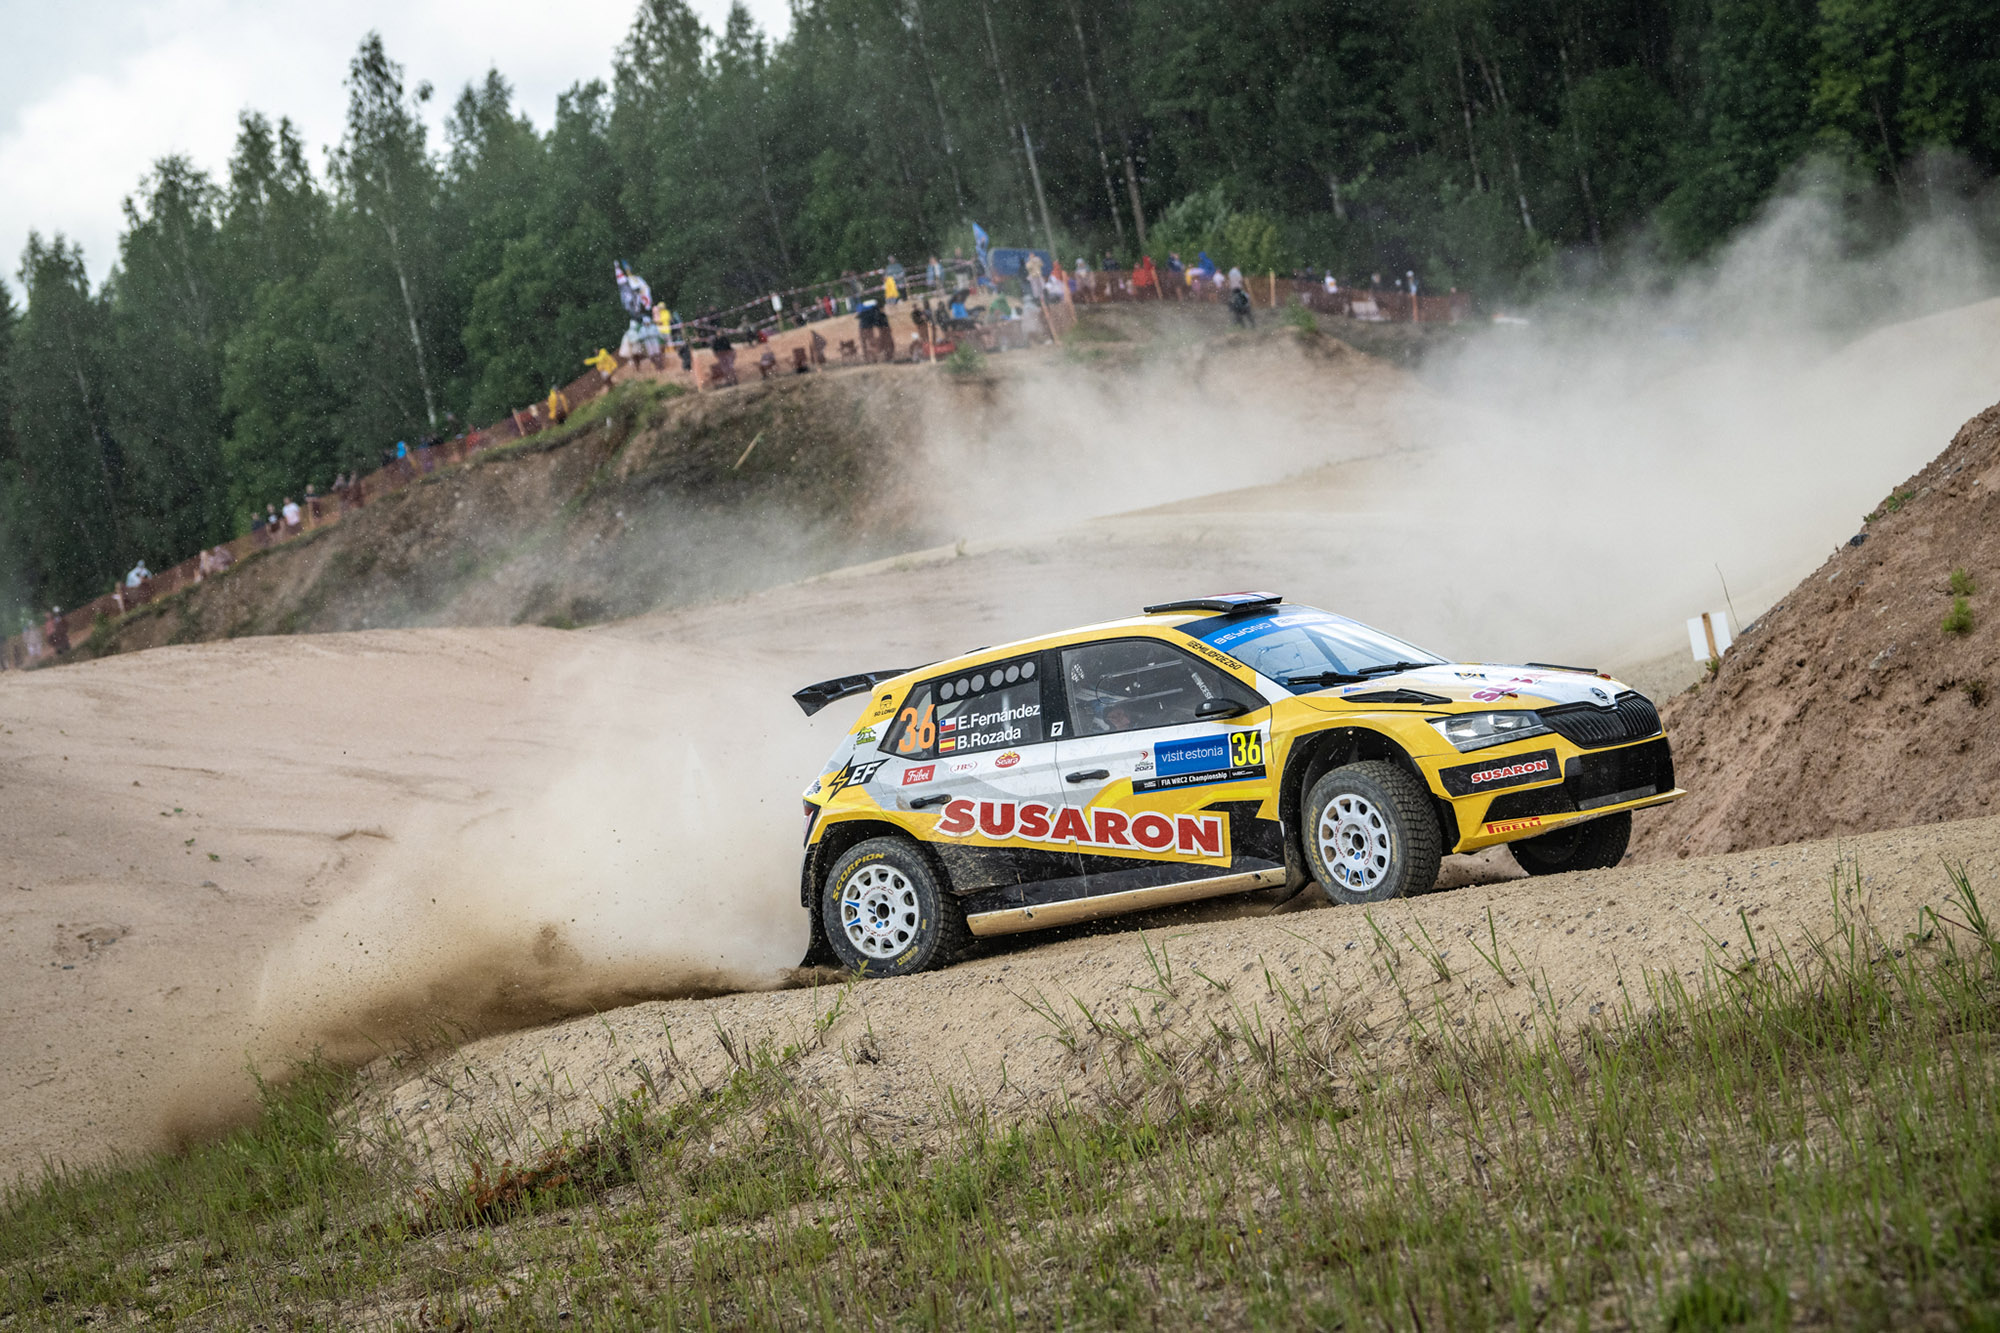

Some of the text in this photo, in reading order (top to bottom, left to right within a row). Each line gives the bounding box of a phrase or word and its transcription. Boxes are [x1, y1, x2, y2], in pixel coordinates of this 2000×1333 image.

[898, 703, 937, 753] 36
[958, 703, 1041, 731] E.Fernández
[957, 727, 1022, 750] B.Rozada
[1231, 731, 1262, 767] 36
[1161, 746, 1224, 763] visit estonia
[847, 762, 882, 786] EF
[954, 763, 973, 772] JBS
[1161, 778, 1172, 787] FIA
[1171, 776, 1188, 785] WRC2
[1188, 771, 1228, 784] Championship
[1472, 759, 1549, 784] SUSARON
[937, 798, 1221, 855] SUSARON
[1486, 816, 1542, 834] PIRELLI
[1309, 806, 1331, 885] SCORPION
[832, 852, 885, 901] SCORPION
